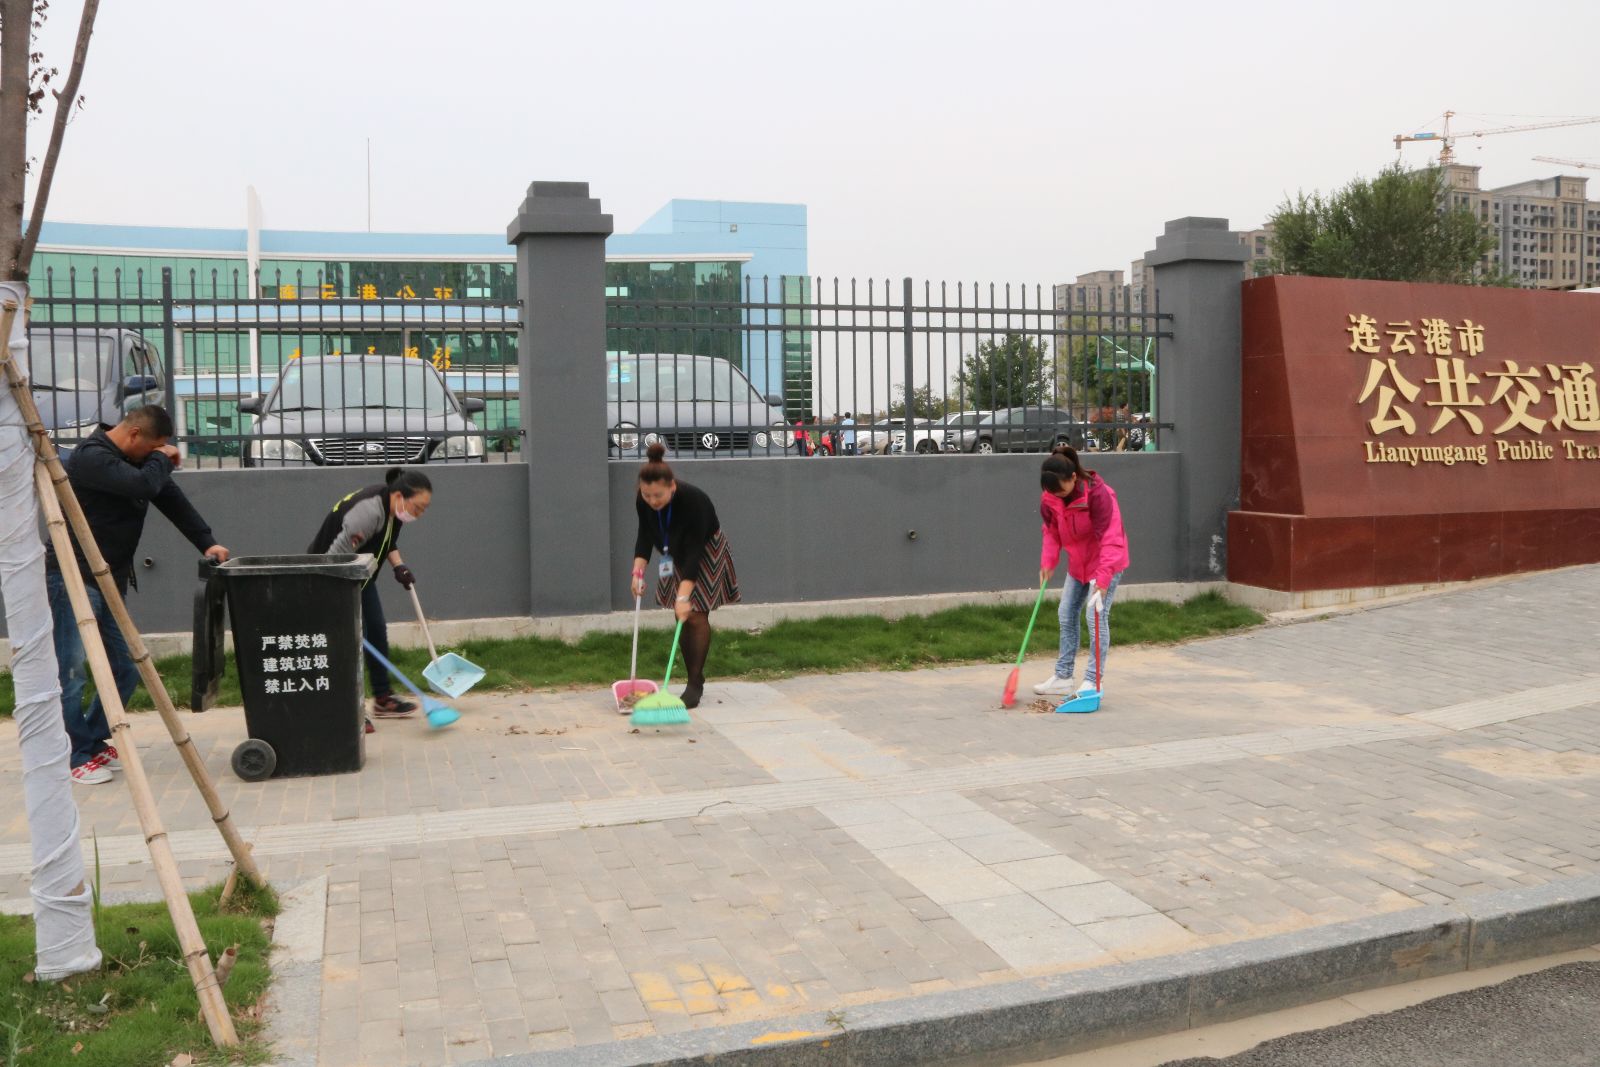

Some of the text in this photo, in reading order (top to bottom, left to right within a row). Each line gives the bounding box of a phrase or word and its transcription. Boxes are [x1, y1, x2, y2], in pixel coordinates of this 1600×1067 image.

[1346, 313, 1485, 357] 连云港市
[1358, 357, 1600, 435] 公共交通
[1364, 441, 1489, 466] Lianyungang
[1496, 440, 1553, 460] Public
[261, 633, 328, 651] 严禁焚烧
[262, 655, 329, 673] 建筑垃圾
[264, 675, 330, 694] 禁止入内
